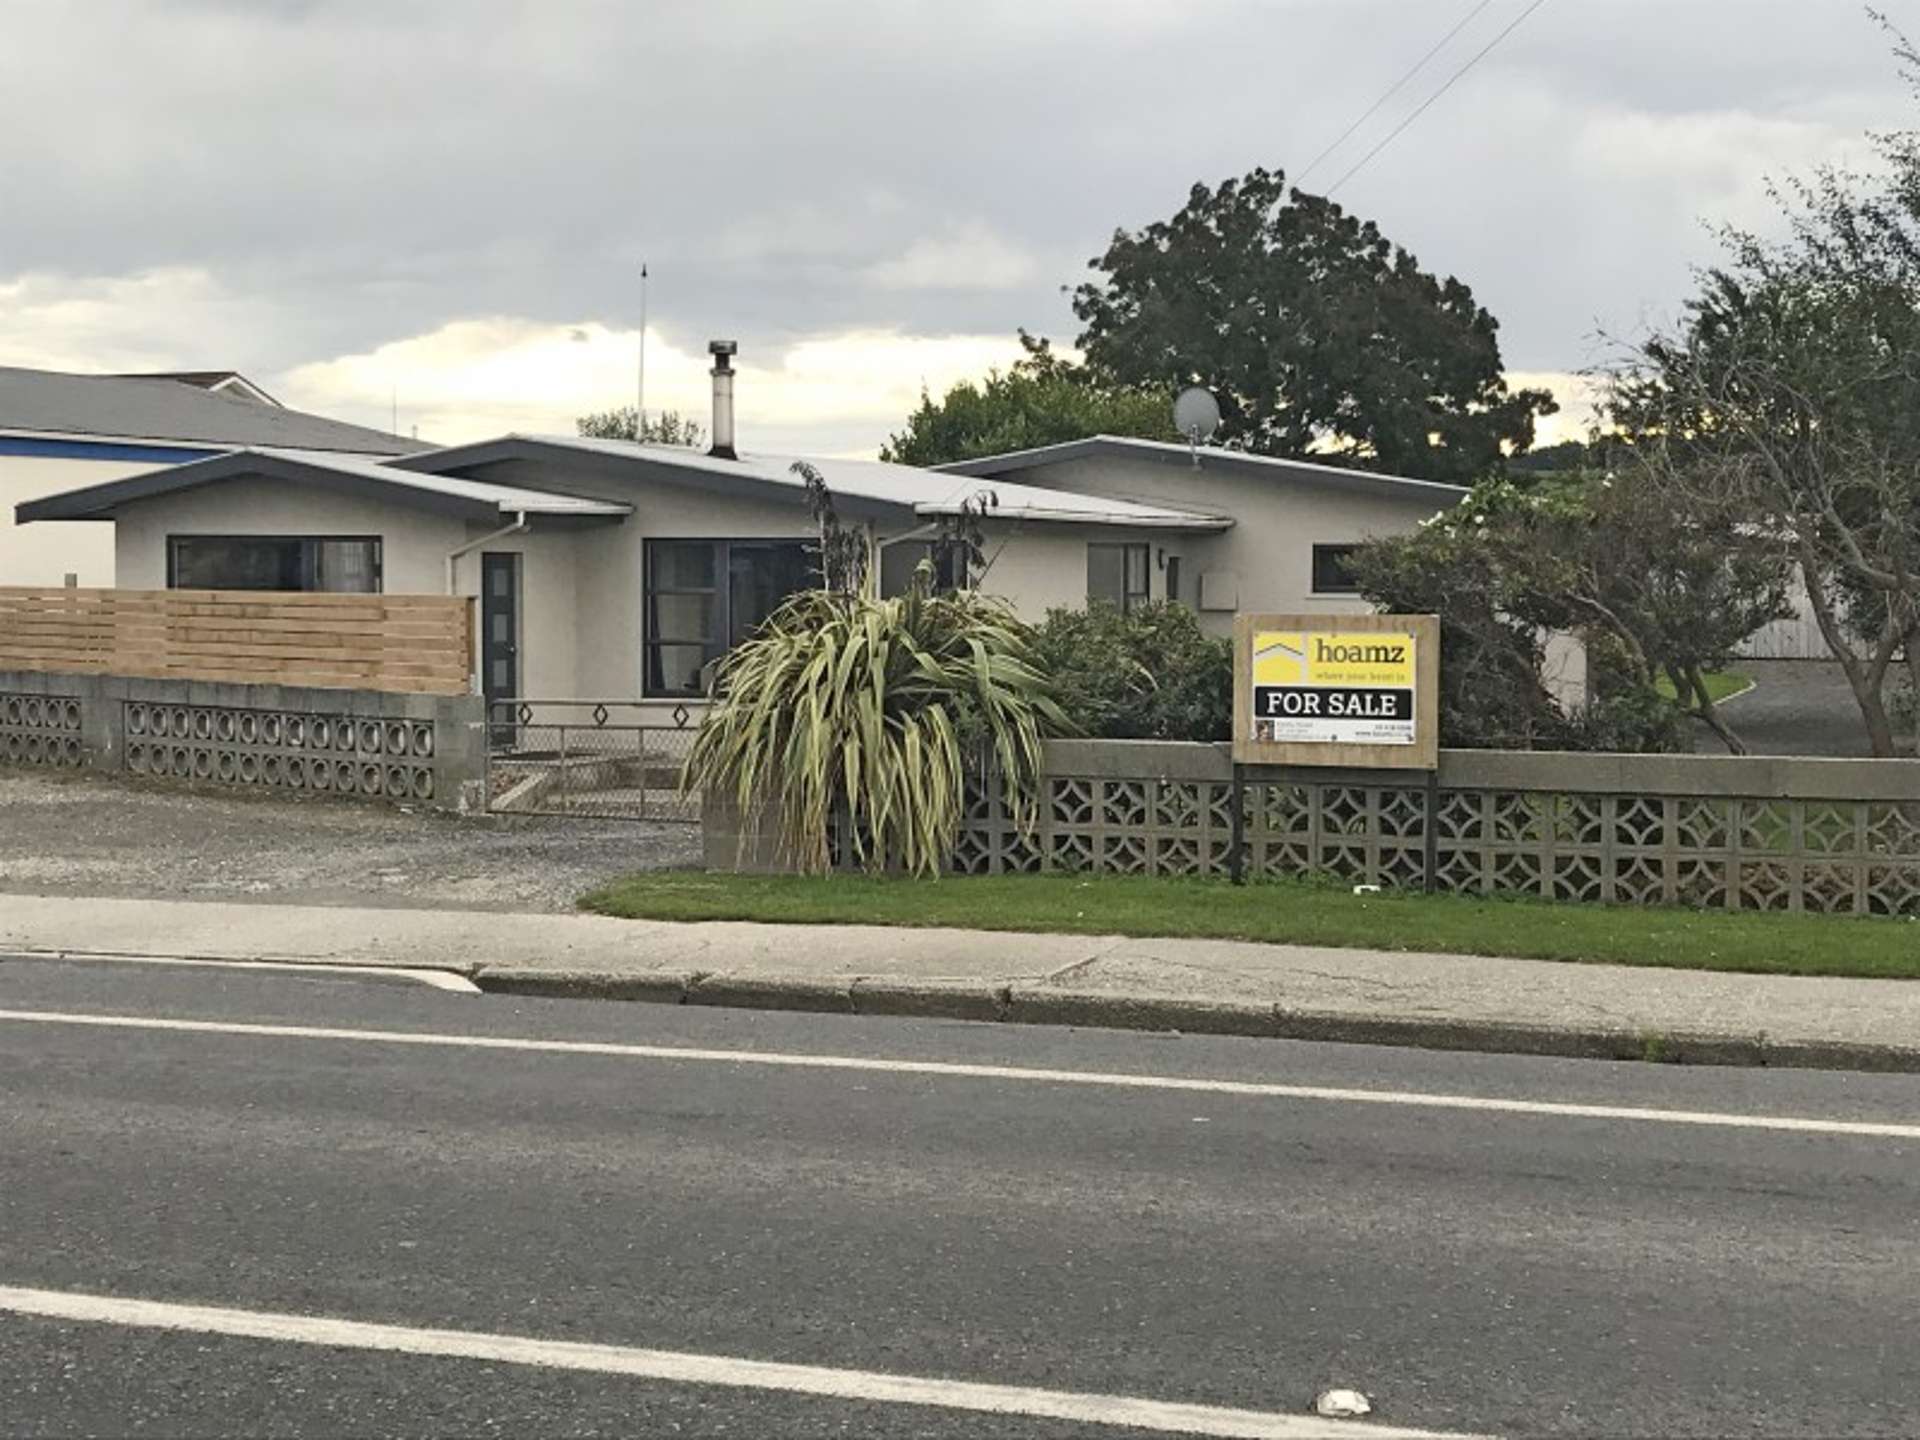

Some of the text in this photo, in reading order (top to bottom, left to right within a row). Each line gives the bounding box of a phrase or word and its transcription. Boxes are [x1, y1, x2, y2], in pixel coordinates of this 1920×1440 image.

[1316, 638, 1405, 664] hoamz
[1266, 692, 1397, 716] FOR SALE
